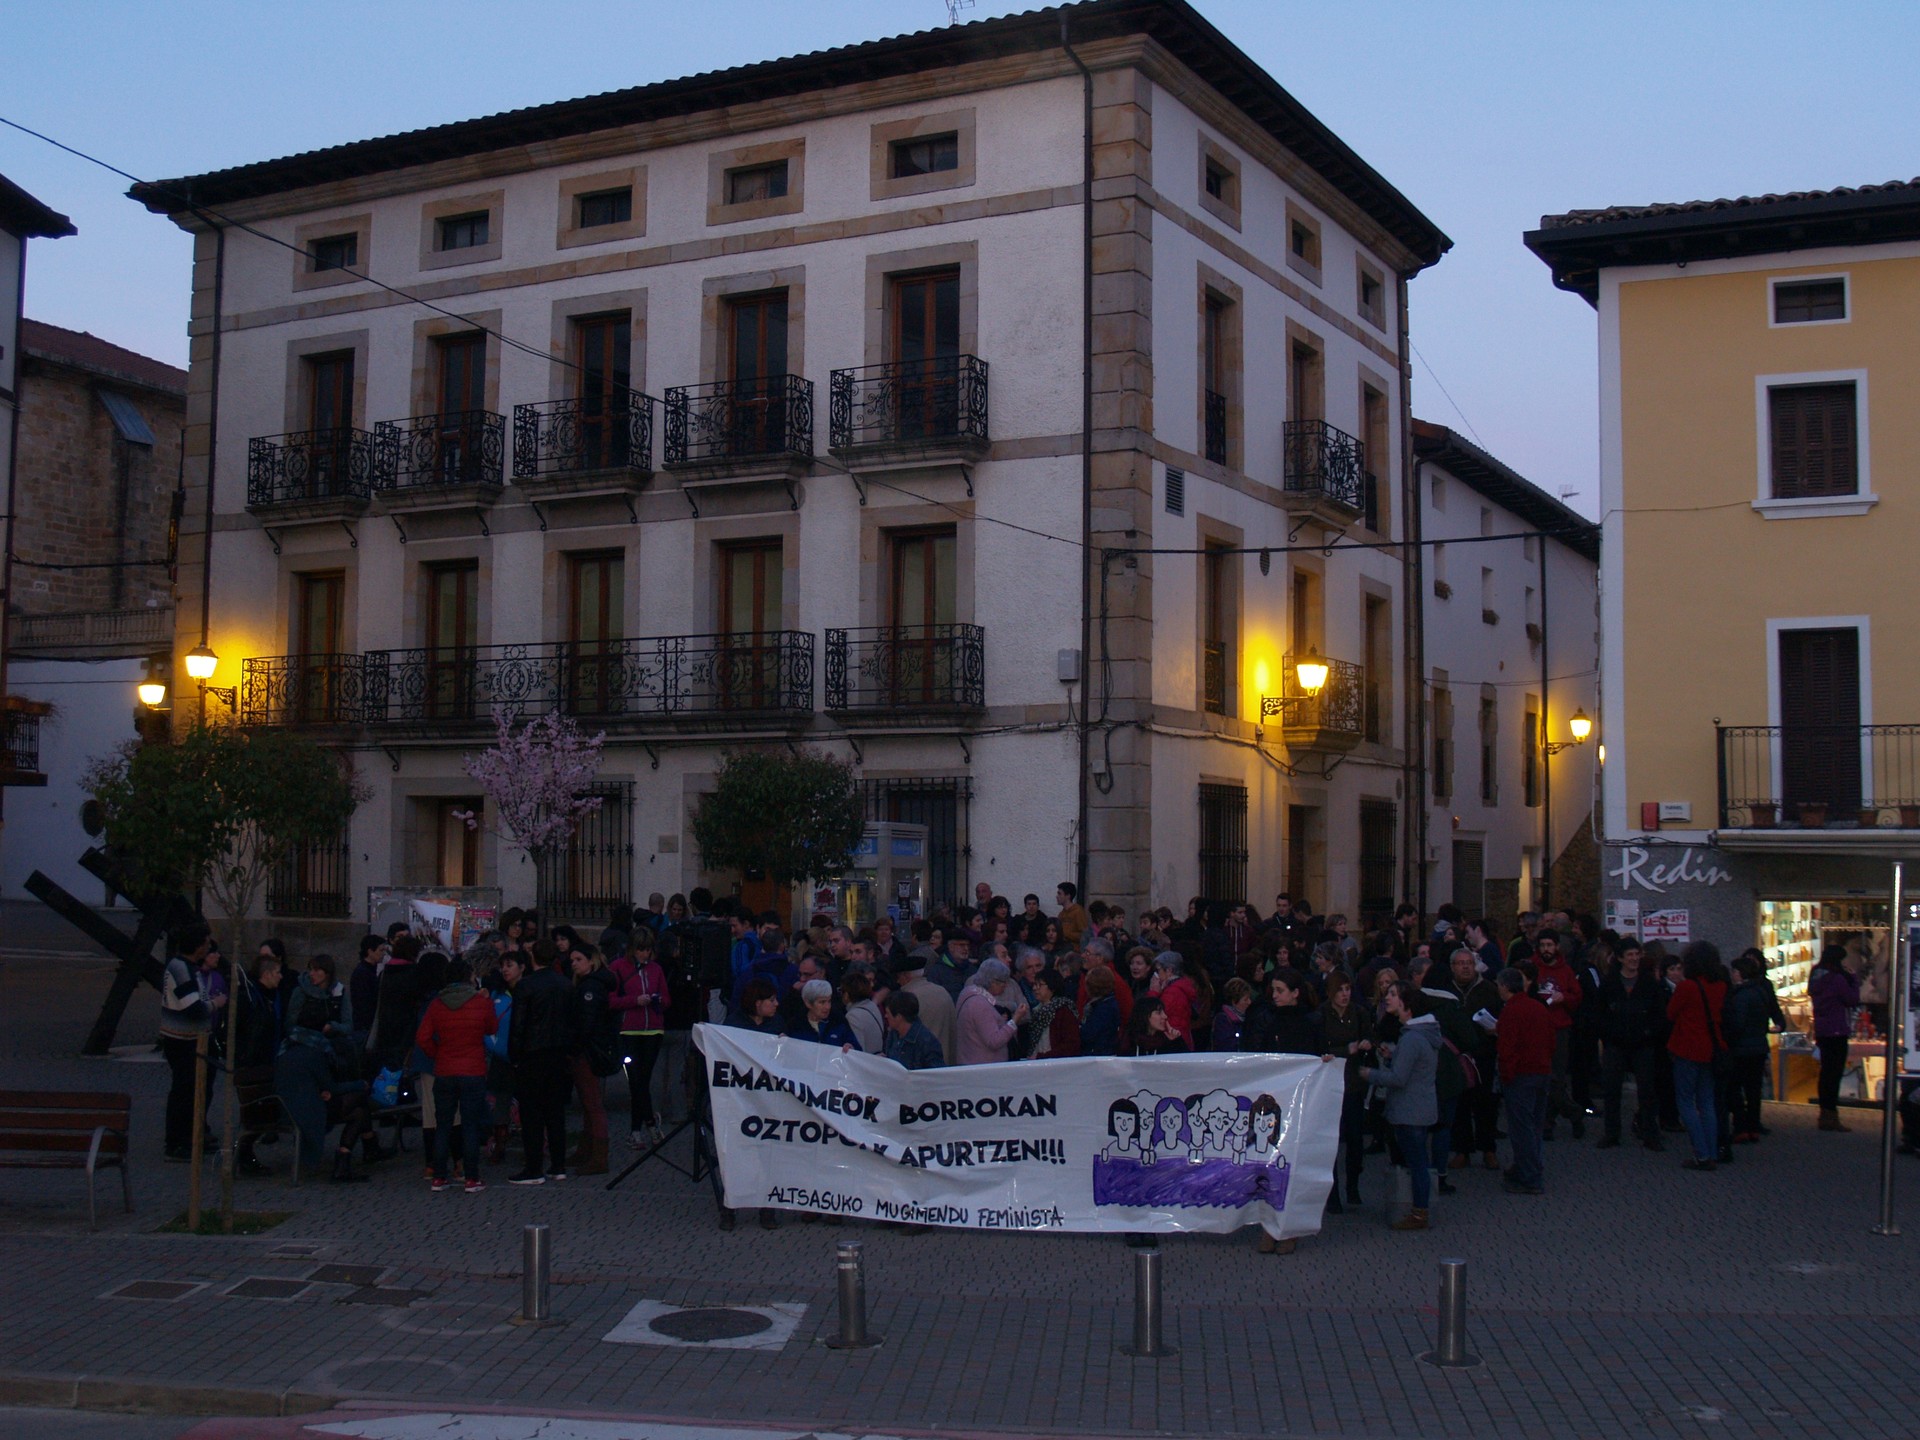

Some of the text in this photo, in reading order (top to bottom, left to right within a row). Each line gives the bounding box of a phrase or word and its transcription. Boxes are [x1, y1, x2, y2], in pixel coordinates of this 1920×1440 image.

[1609, 847, 1733, 893] Redin
[432, 917, 450, 931] JUEGO
[900, 1094, 1057, 1125] BORROKAN
[899, 1139, 1067, 1169] APURTZEN!!!
[768, 1186, 863, 1213] ALTSASUKO
